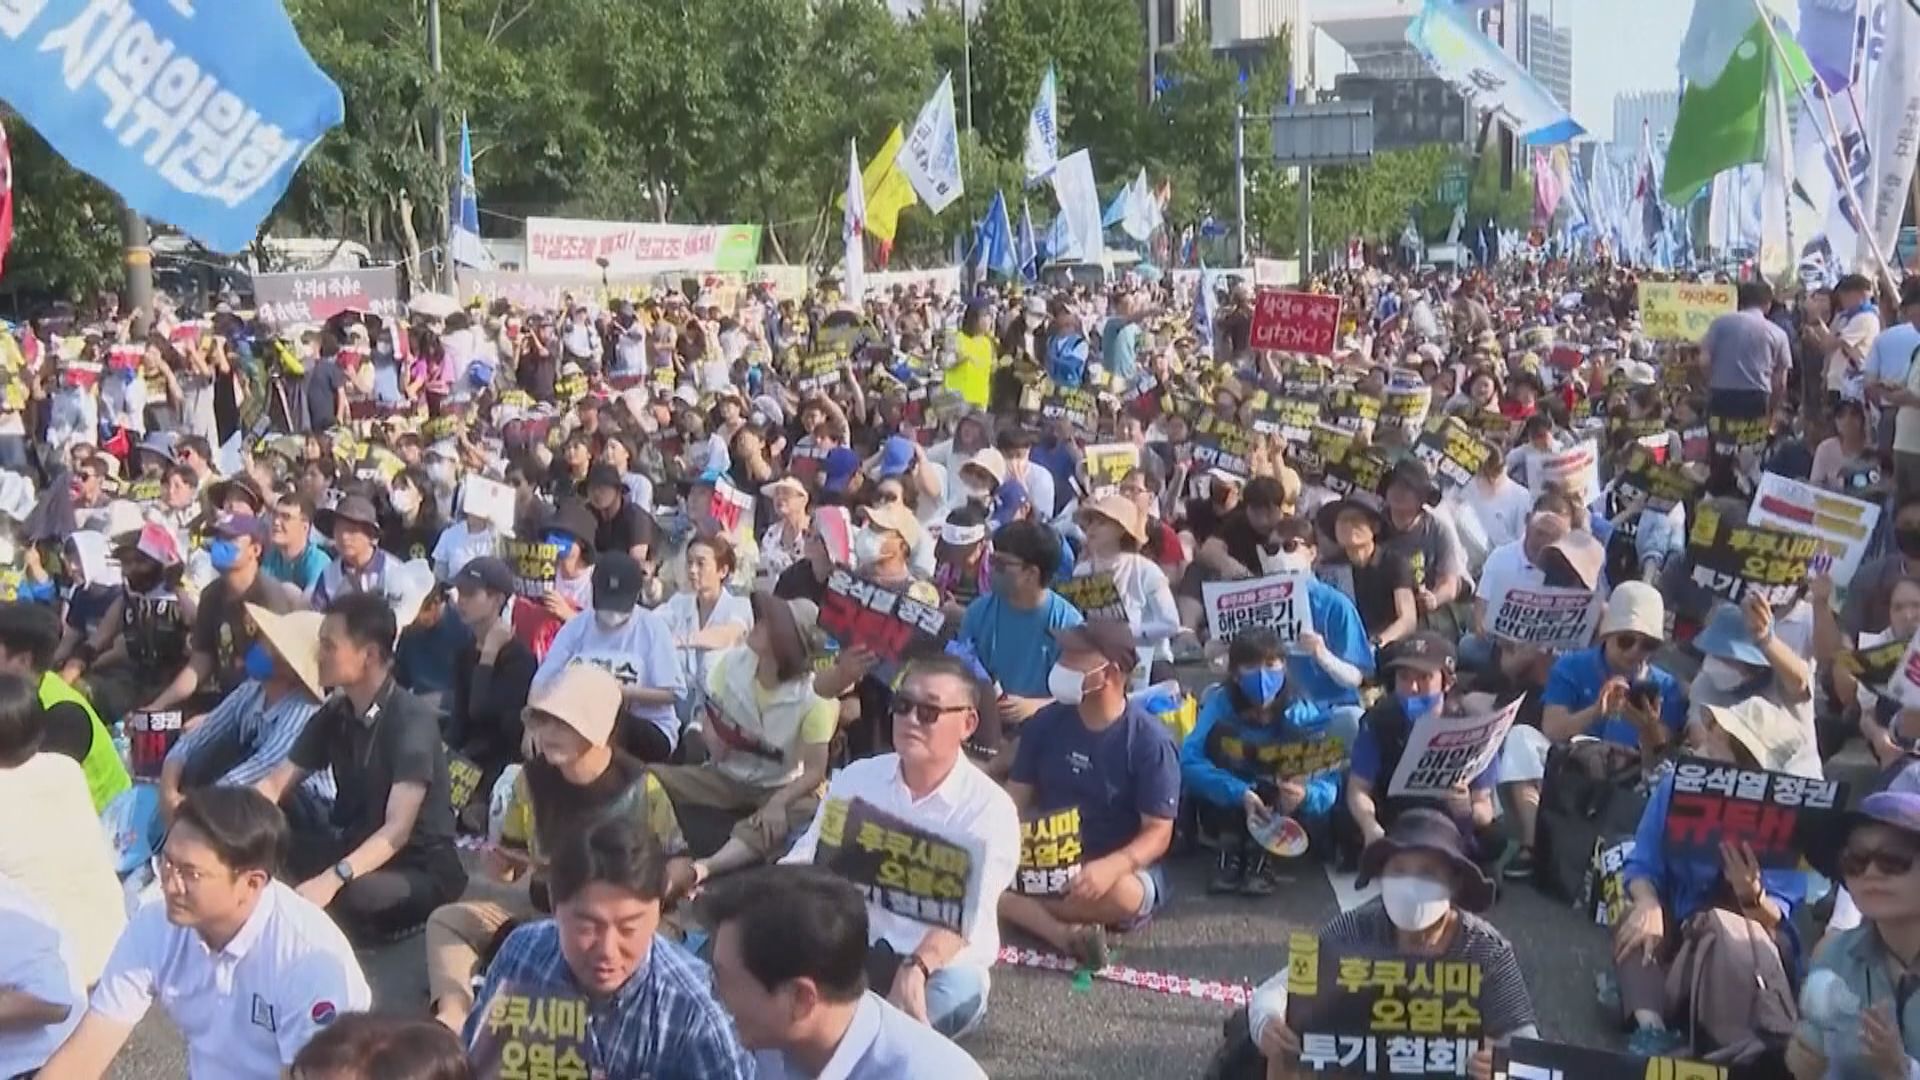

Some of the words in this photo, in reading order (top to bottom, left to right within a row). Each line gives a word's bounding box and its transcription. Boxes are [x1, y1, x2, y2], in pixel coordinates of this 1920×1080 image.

[1674, 763, 1769, 801] 윤석열
[1773, 775, 1838, 808] 정권
[856, 820, 969, 873] 후쿠시마
[876, 861, 964, 898] 오염수
[1336, 956, 1484, 999] 후쿠시마
[488, 993, 588, 1043] 후쿠시마
[1369, 997, 1482, 1033] 오염수
[500, 1040, 588, 1080] 오염수
[1300, 1032, 1377, 1073] 투기
